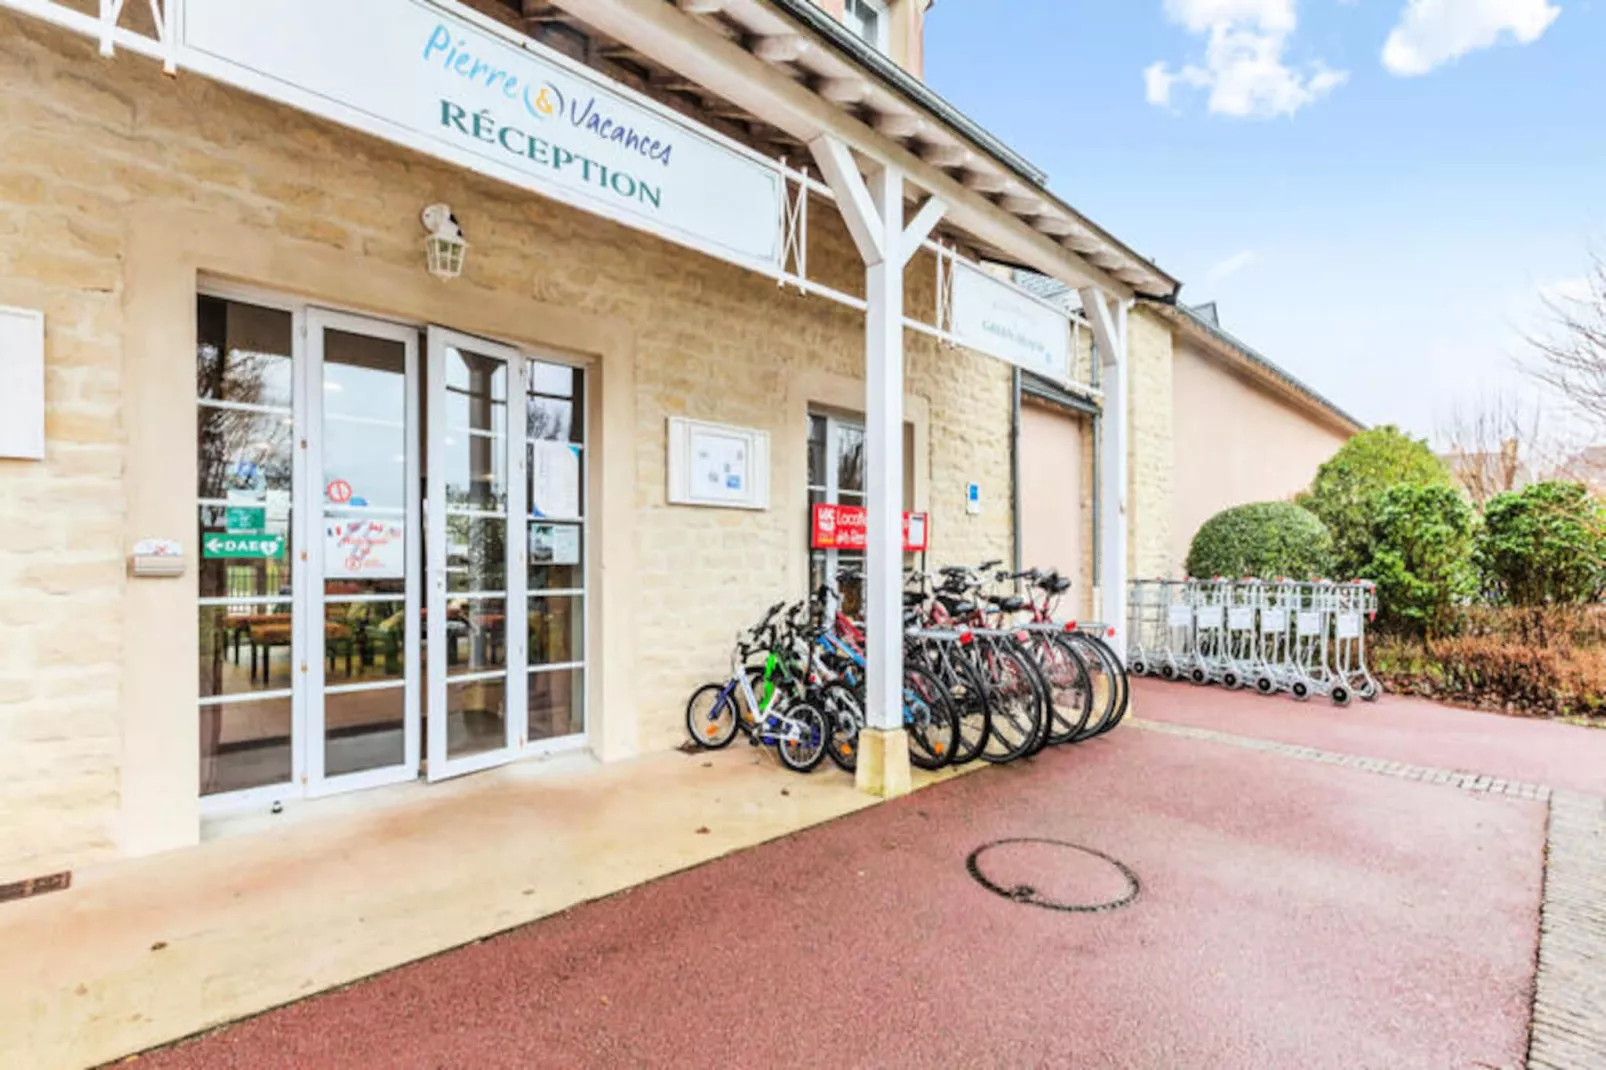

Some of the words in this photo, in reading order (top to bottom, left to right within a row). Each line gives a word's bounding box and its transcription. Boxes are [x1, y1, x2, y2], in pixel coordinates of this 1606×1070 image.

[422, 23, 517, 99] Pierre
[570, 97, 672, 167] Vacances
[439, 99, 662, 209] RÉCEPTION
[224, 539, 259, 552] DAE
